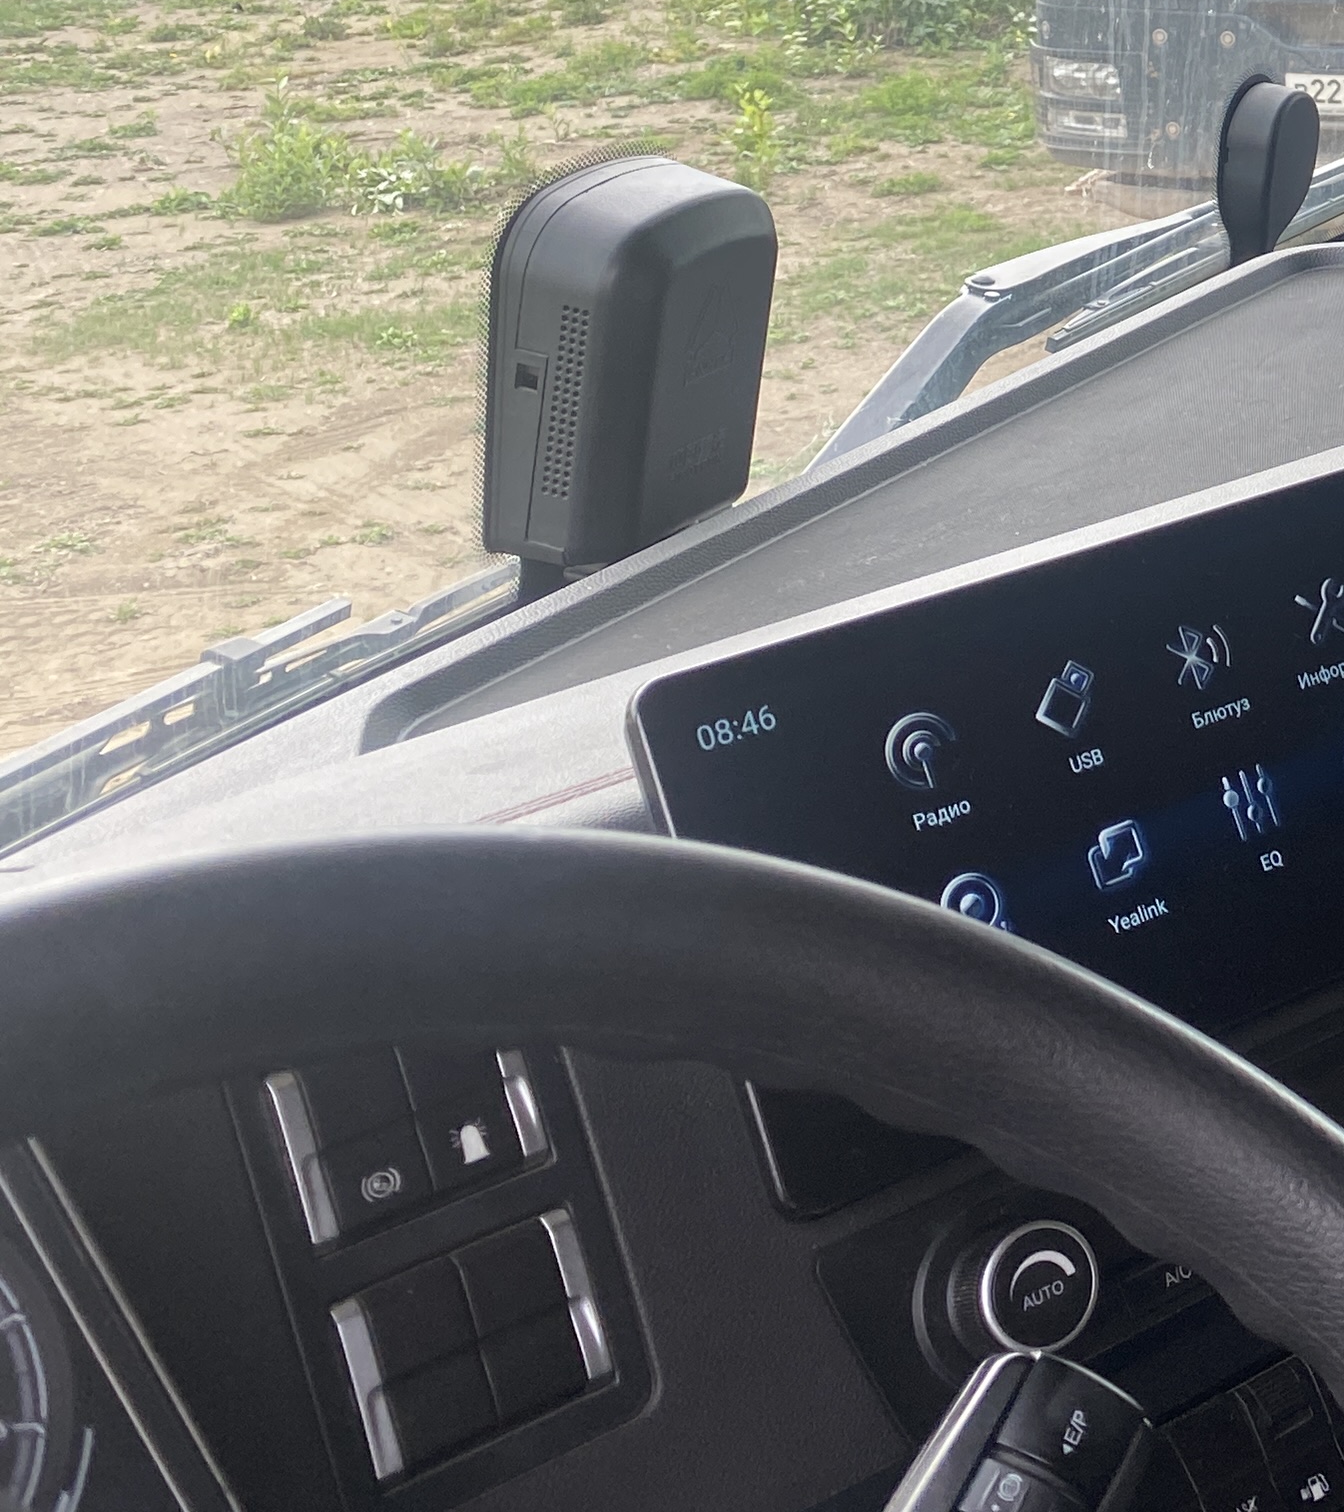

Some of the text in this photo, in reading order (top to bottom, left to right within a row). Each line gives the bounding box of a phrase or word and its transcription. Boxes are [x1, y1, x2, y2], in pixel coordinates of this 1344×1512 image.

[696, 704, 777, 752] 08:46
[1191, 697, 1251, 729] Блютуз
[1068, 748, 1105, 774] USB
[912, 799, 972, 832] Радио
[1259, 849, 1285, 873] EQ
[1107, 897, 1169, 935] Yealink
[1022, 1280, 1065, 1312] AUTO
